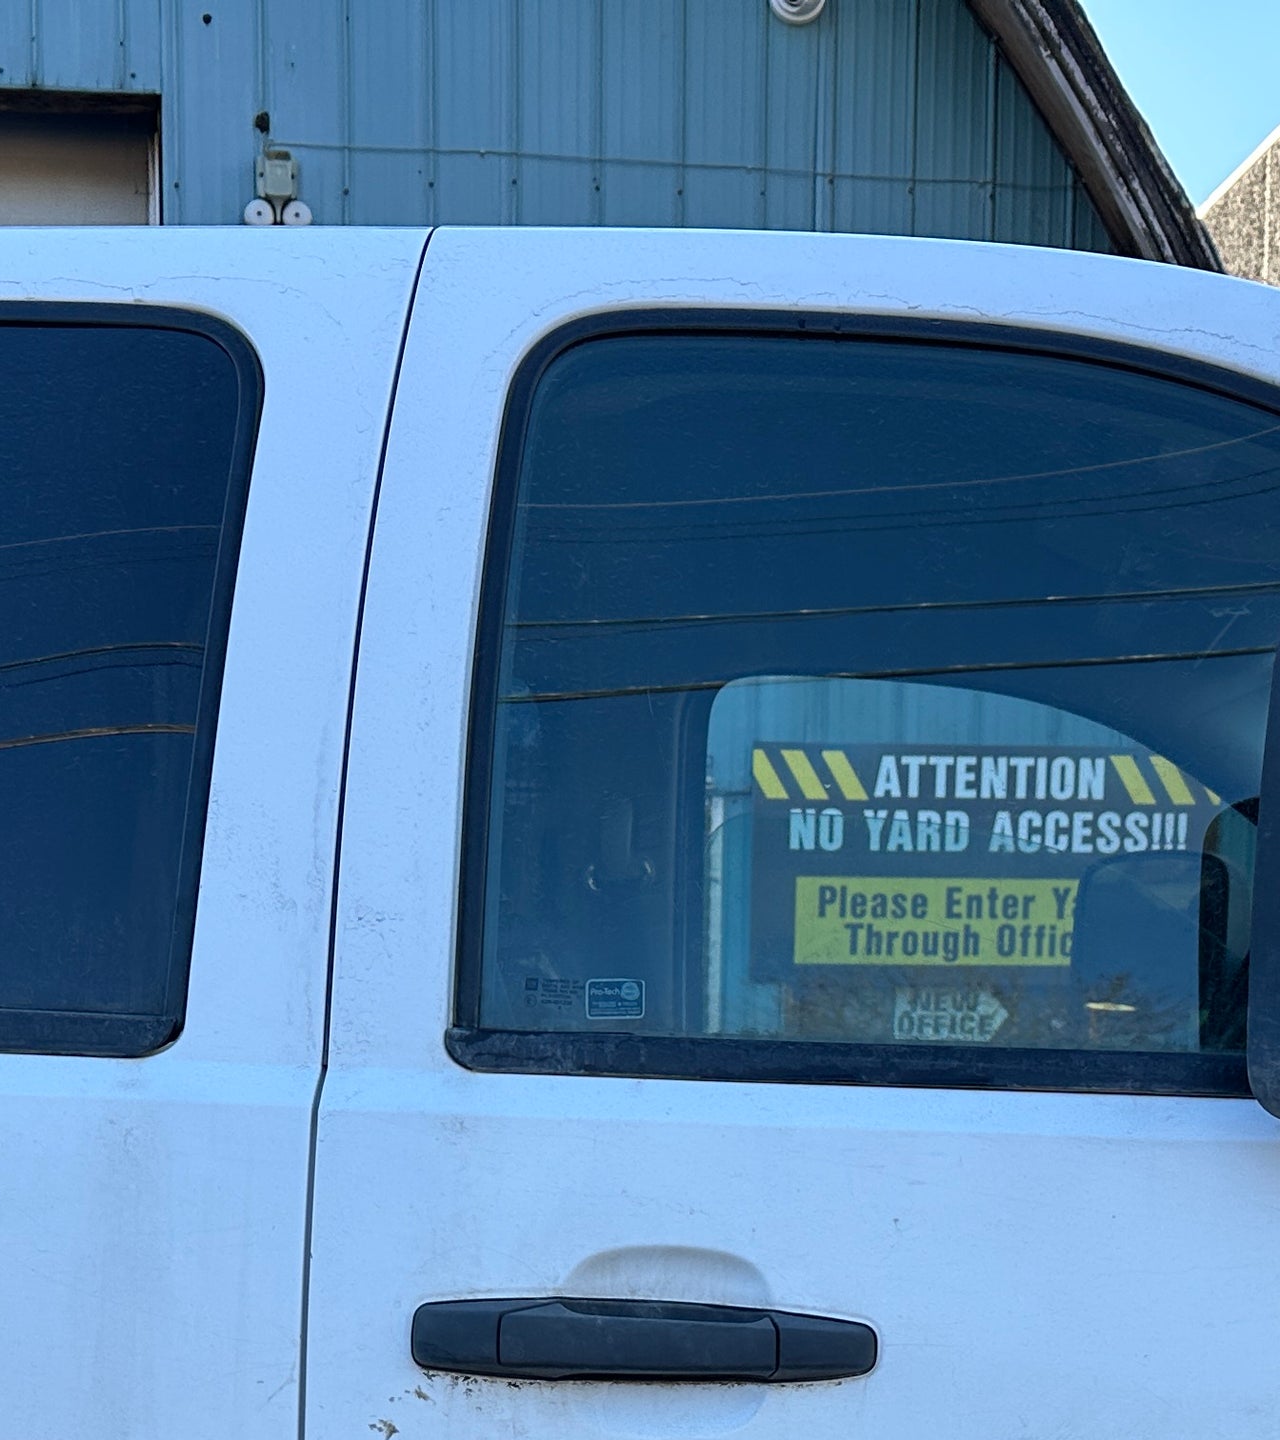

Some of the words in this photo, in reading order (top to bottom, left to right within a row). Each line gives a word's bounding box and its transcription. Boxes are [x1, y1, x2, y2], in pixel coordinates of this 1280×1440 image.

[874, 755, 1106, 800] ATTENTION
[789, 808, 844, 851] NO
[863, 809, 970, 852] YARD
[989, 811, 1188, 853] ACCESS!!!
[818, 885, 928, 919] Please
[946, 886, 1036, 920] Enter
[1052, 887, 1077, 920] Y
[844, 923, 980, 962] Through
[898, 1011, 994, 1036] OFFICE
